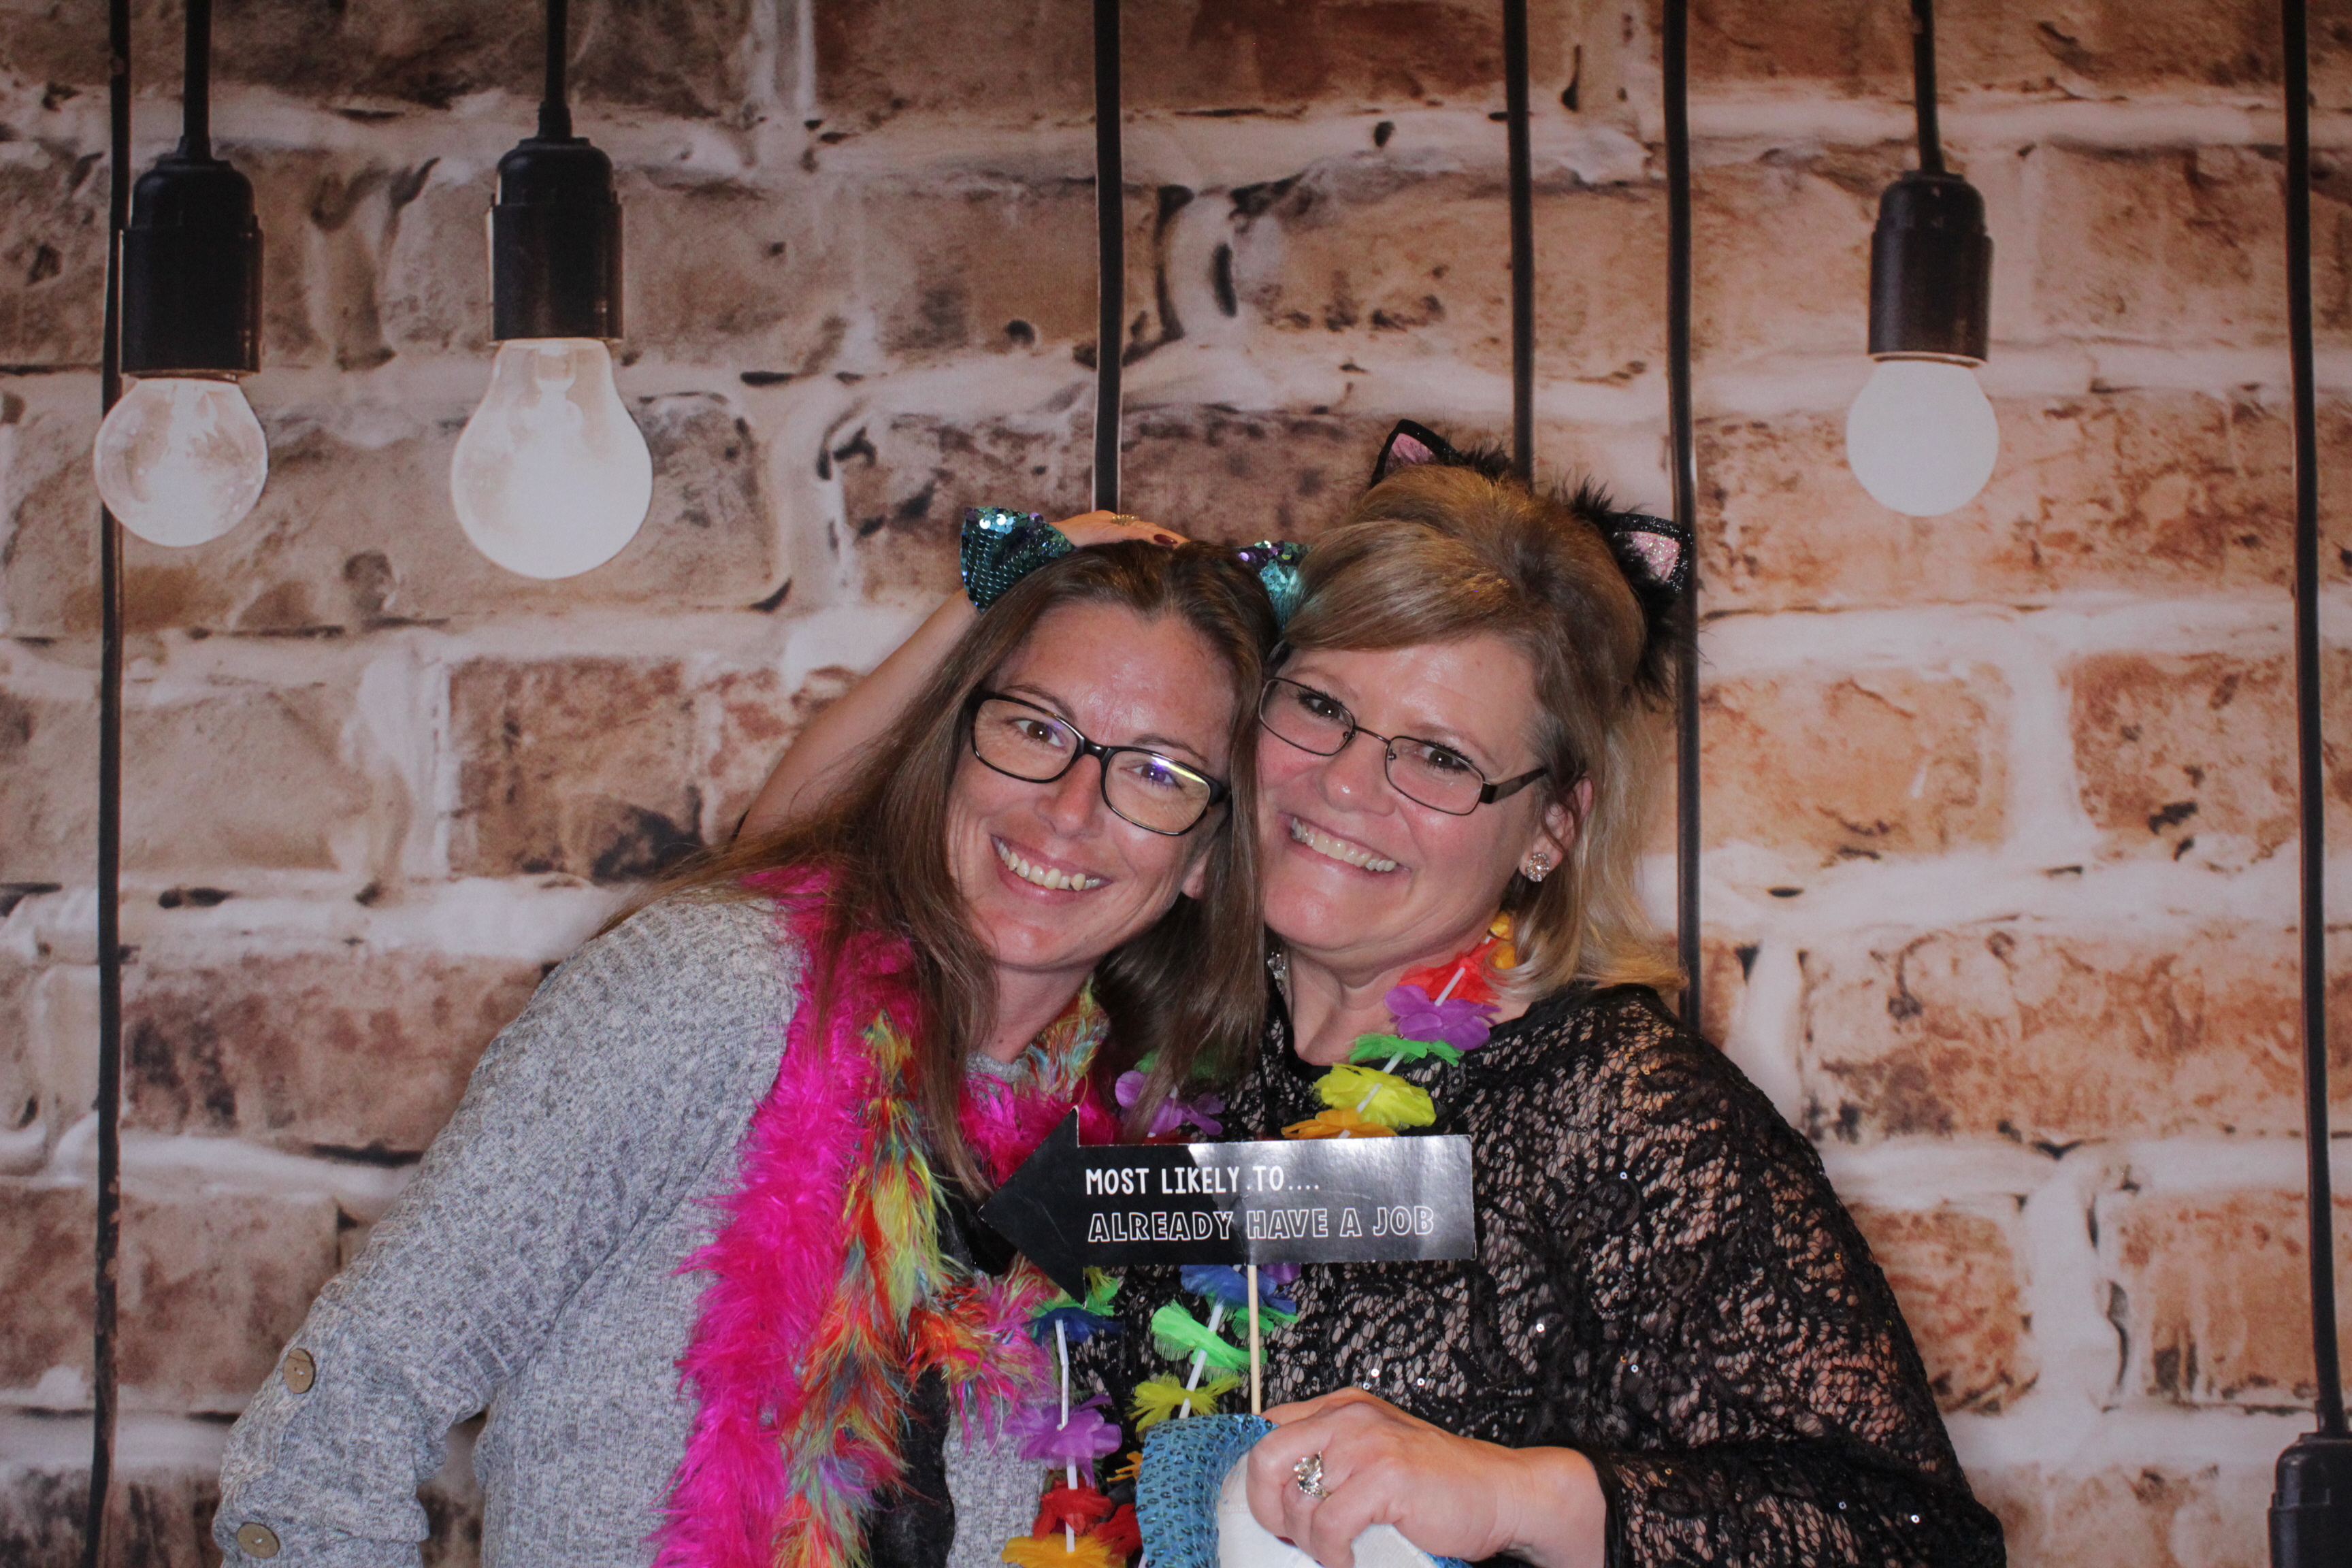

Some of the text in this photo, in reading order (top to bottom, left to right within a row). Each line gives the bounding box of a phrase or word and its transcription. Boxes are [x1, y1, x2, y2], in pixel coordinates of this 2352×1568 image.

[1085, 1167, 1149, 1195] MOST
[1161, 1166, 1240, 1194] LIKELY
[1088, 1205, 1434, 1243] ALREADY HAVE A JOB
